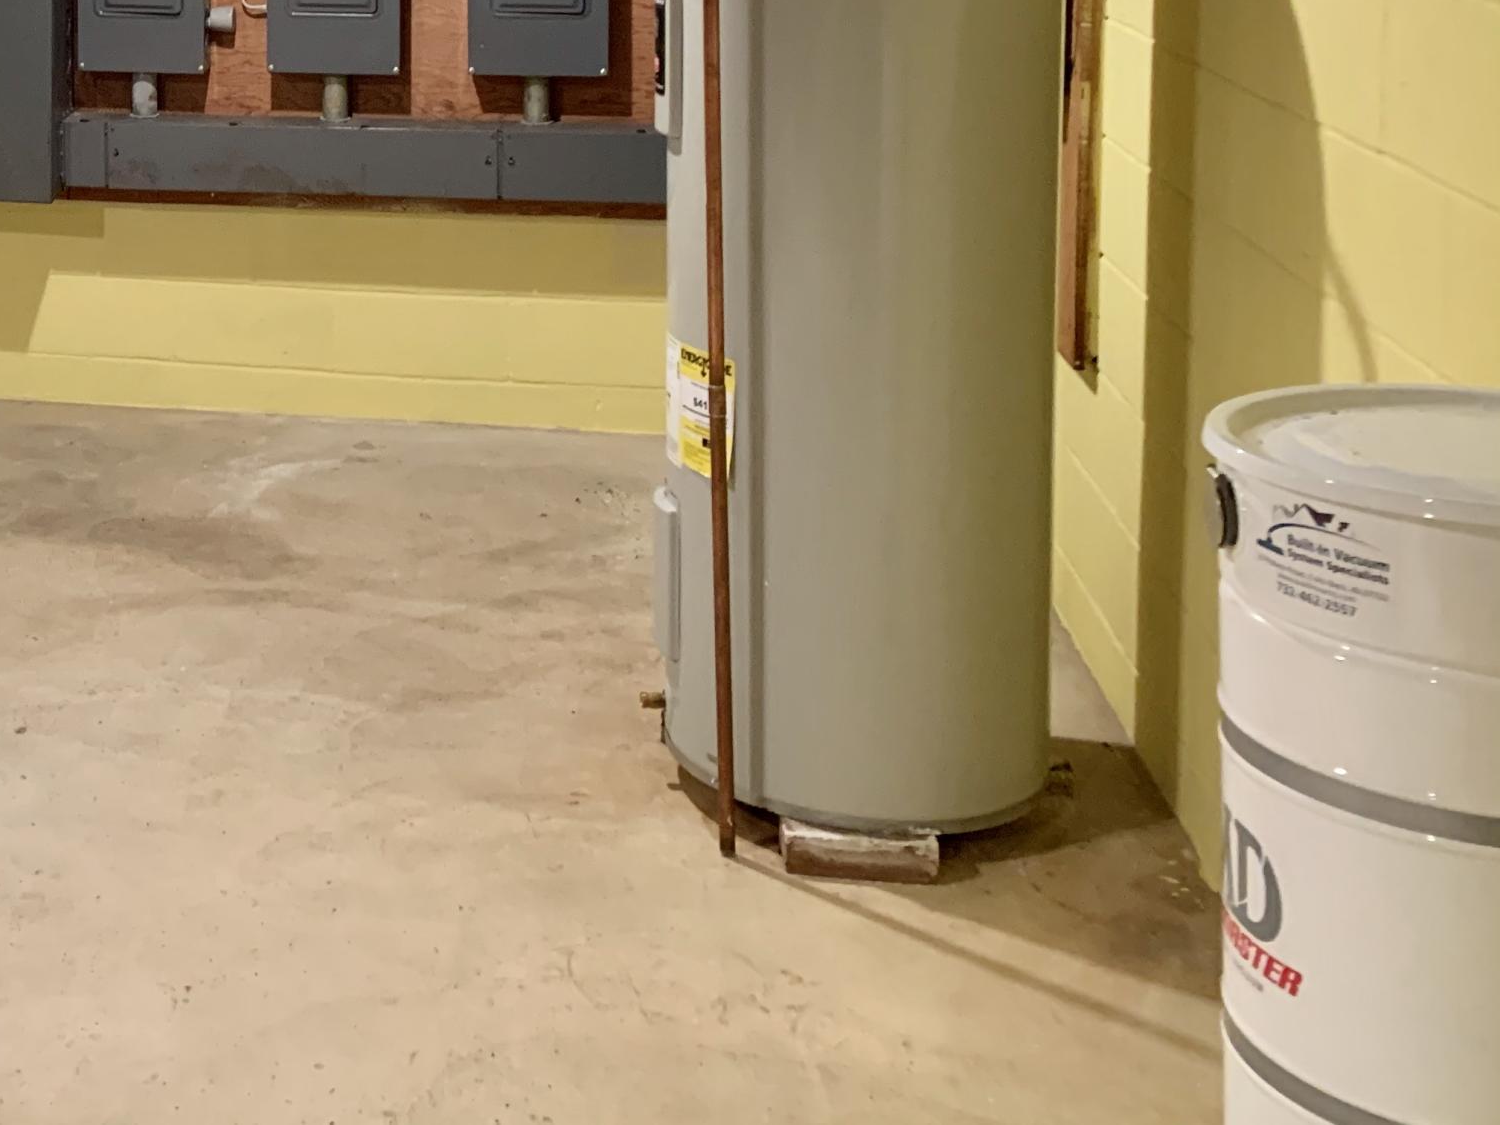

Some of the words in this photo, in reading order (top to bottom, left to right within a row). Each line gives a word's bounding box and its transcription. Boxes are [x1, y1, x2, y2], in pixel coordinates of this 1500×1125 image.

[1287, 548, 1324, 567] System
[1327, 561, 1389, 585] Specialists
[1334, 548, 1390, 572] Vacuum
